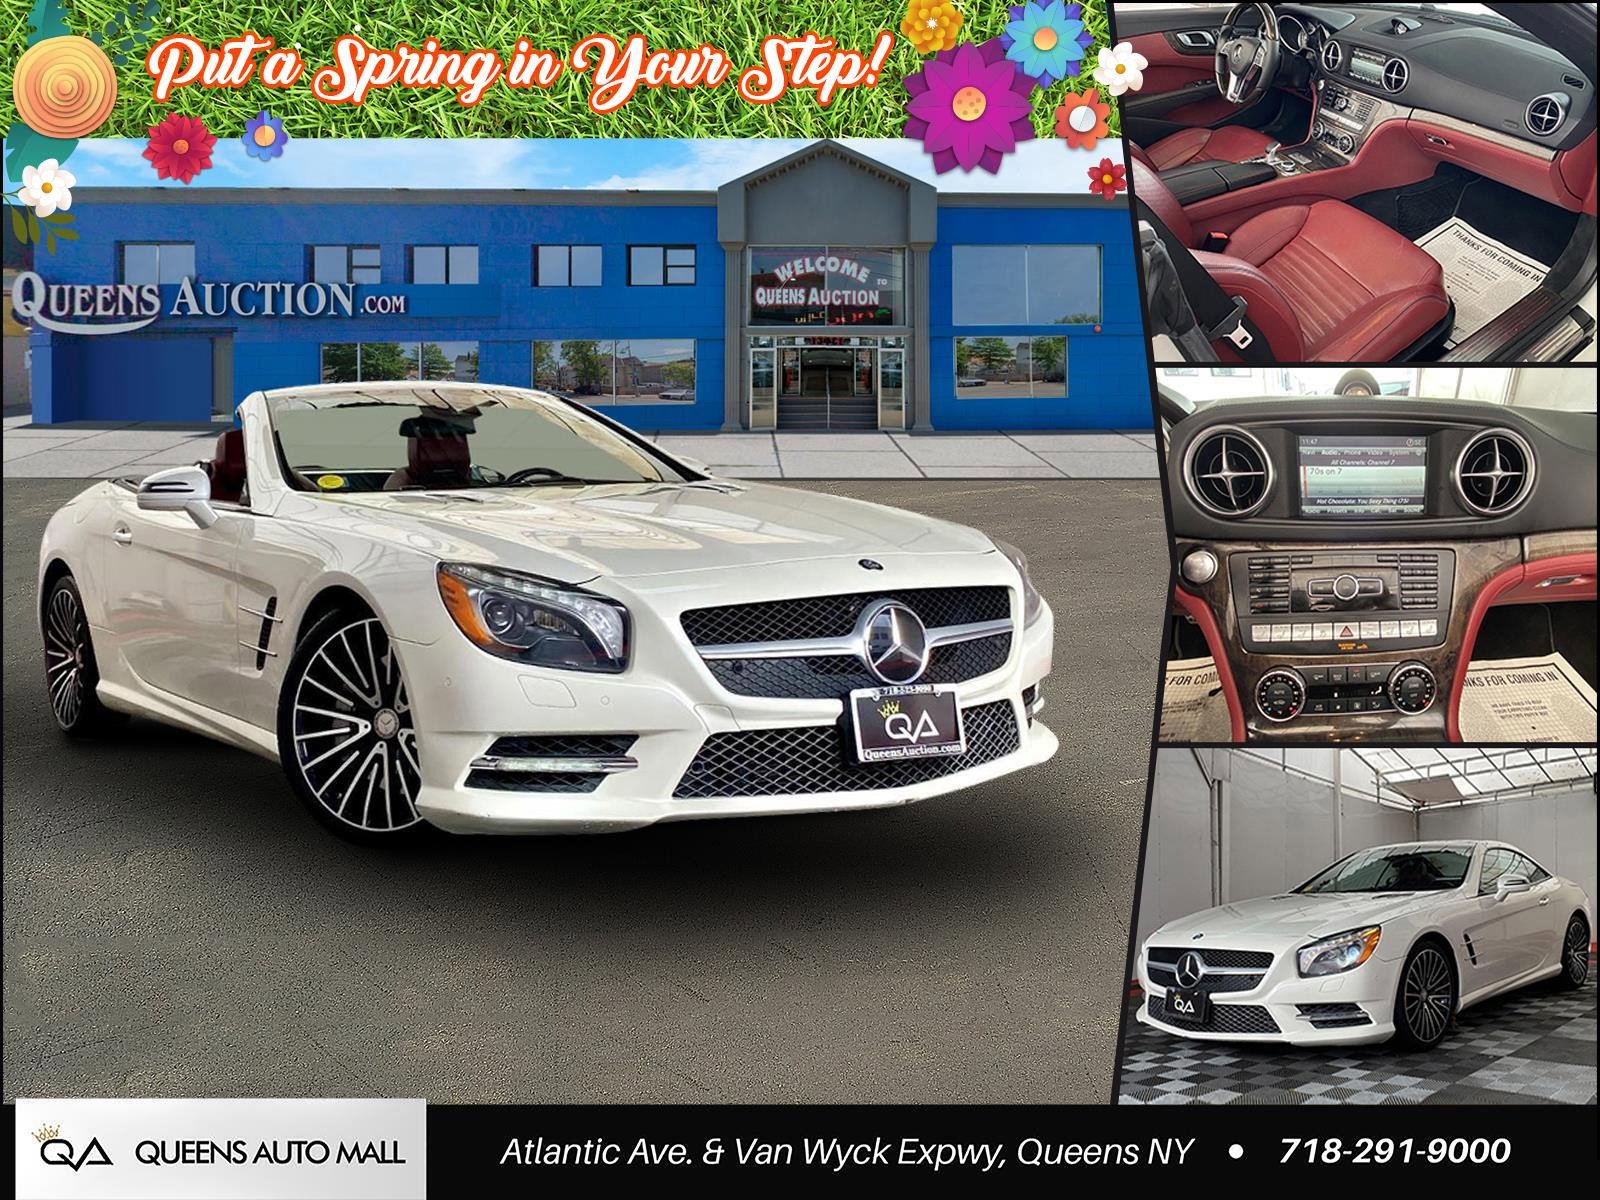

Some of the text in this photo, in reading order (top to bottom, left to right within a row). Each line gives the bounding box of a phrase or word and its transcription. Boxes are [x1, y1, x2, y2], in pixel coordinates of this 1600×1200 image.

[1453, 230, 1482, 250] THANKS
[1480, 247, 1499, 260] FOR
[1497, 256, 1530, 277] COMING
[1531, 273, 1543, 283] IN
[774, 256, 888, 286] WELCOME TO
[12, 271, 160, 334] QUEENS
[756, 287, 879, 306] QUEENS AUCTION
[1309, 467, 1325, 475] 70s
[1337, 467, 1343, 475] 7
[1169, 672, 1218, 686] FOR COM
[1484, 674, 1508, 686] FOR
[1506, 671, 1546, 685] COMING
[1544, 671, 1559, 681] IN
[864, 743, 961, 760] QueensAuction.com
